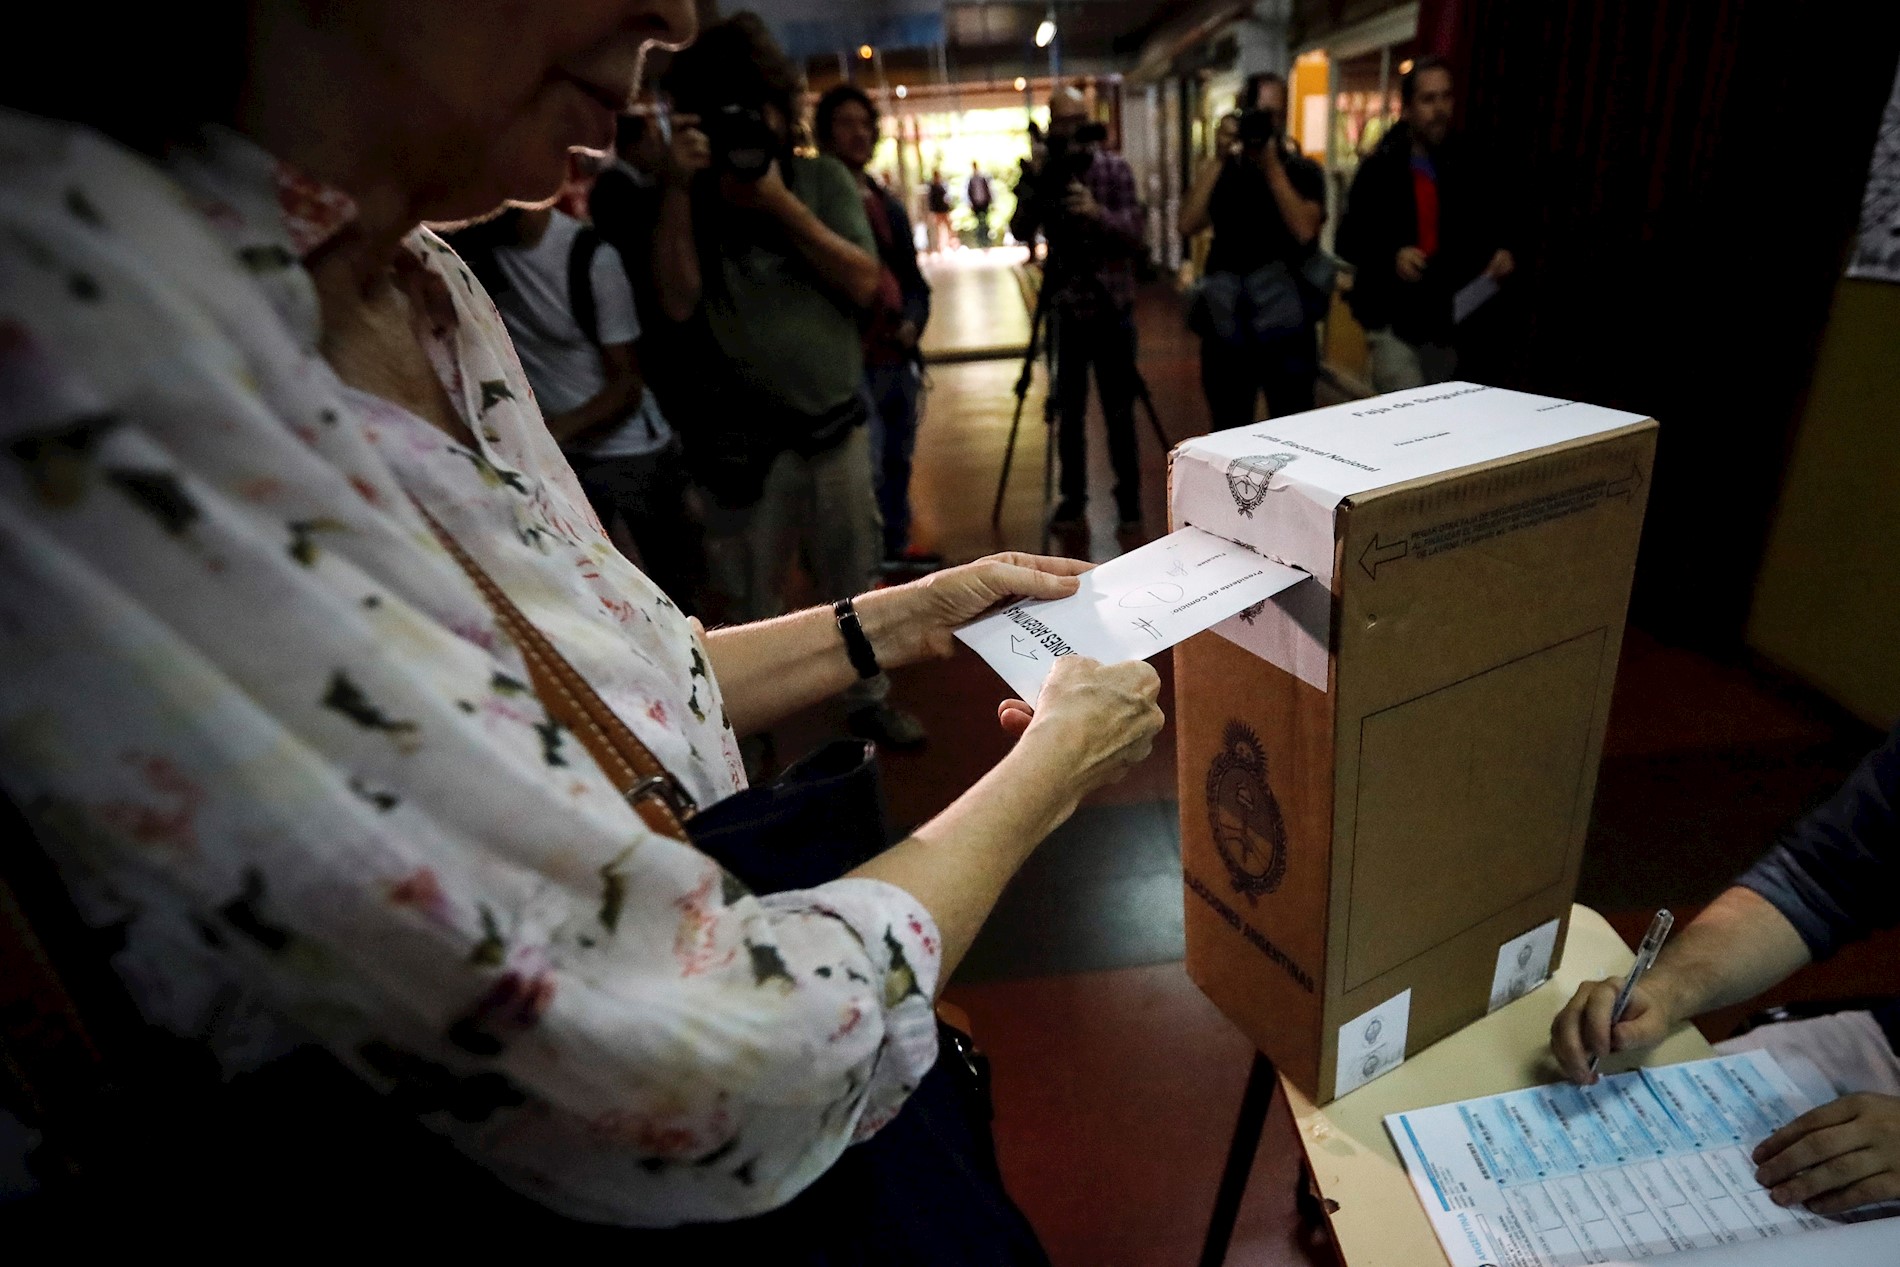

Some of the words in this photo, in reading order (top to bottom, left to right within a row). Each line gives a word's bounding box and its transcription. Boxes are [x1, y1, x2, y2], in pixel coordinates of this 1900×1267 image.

[1352, 407, 1391, 418] Faja
[1392, 402, 1414, 410] de
[1251, 433, 1282, 443] Junta
[1281, 440, 1330, 457] Electoral
[1328, 453, 1381, 473] Nacional
[1208, 589, 1219, 597] de
[1219, 570, 1264, 592] Presidente
[1170, 596, 1208, 615] Comicio:
[1002, 606, 1053, 638] ARGENTINAS
[1040, 633, 1078, 657] IONES
[1243, 922, 1315, 994] ARGENTINAS
[1457, 1212, 1487, 1261] ARGENTINA
